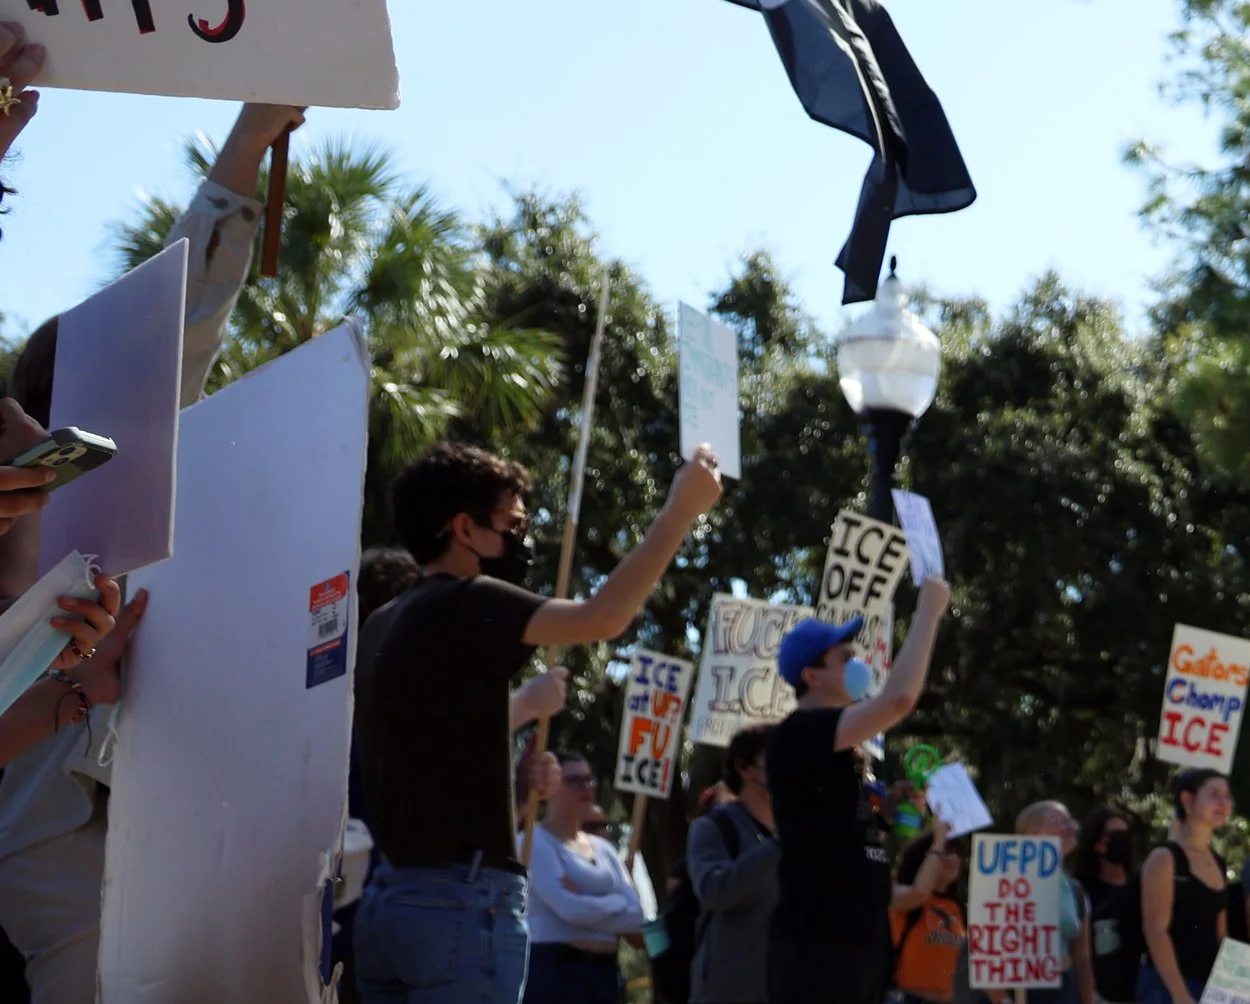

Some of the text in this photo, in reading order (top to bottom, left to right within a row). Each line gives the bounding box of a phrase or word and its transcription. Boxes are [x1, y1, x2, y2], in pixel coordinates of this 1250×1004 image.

[833, 516, 906, 573] ICE
[826, 562, 888, 608] OFF
[634, 655, 682, 693] ICE
[630, 716, 671, 760] FU
[1161, 710, 1229, 757] ICE
[622, 753, 671, 792] ICE!
[977, 839, 1060, 878] UFPD
[998, 877, 1032, 899] DO
[983, 901, 1037, 923] THE
[968, 924, 1058, 955] RIGHT
[971, 956, 1061, 983] THING
